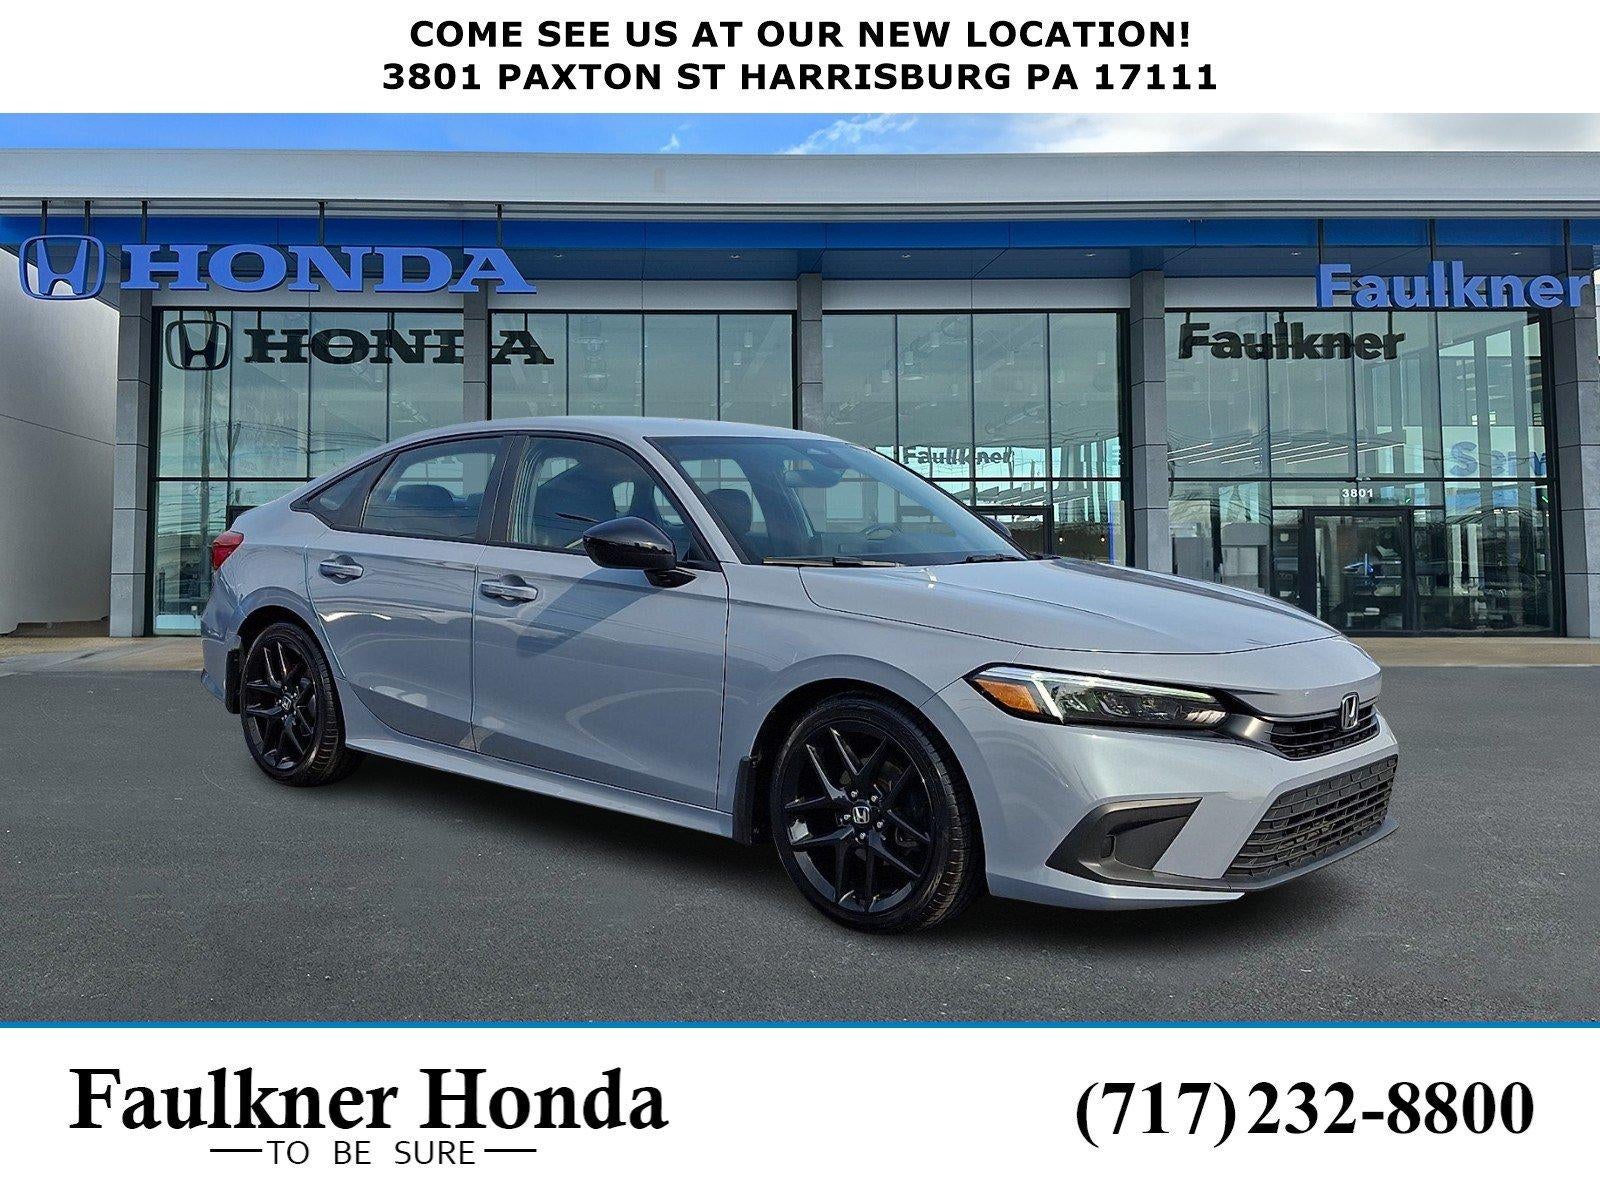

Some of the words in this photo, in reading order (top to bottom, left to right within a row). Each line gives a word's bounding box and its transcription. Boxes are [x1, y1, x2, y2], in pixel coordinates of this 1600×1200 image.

[121, 243, 537, 294] HONDA
[1317, 261, 1591, 310] Faulkner
[1178, 321, 1405, 361] Faulkner
[1341, 488, 1373, 498] 3801
